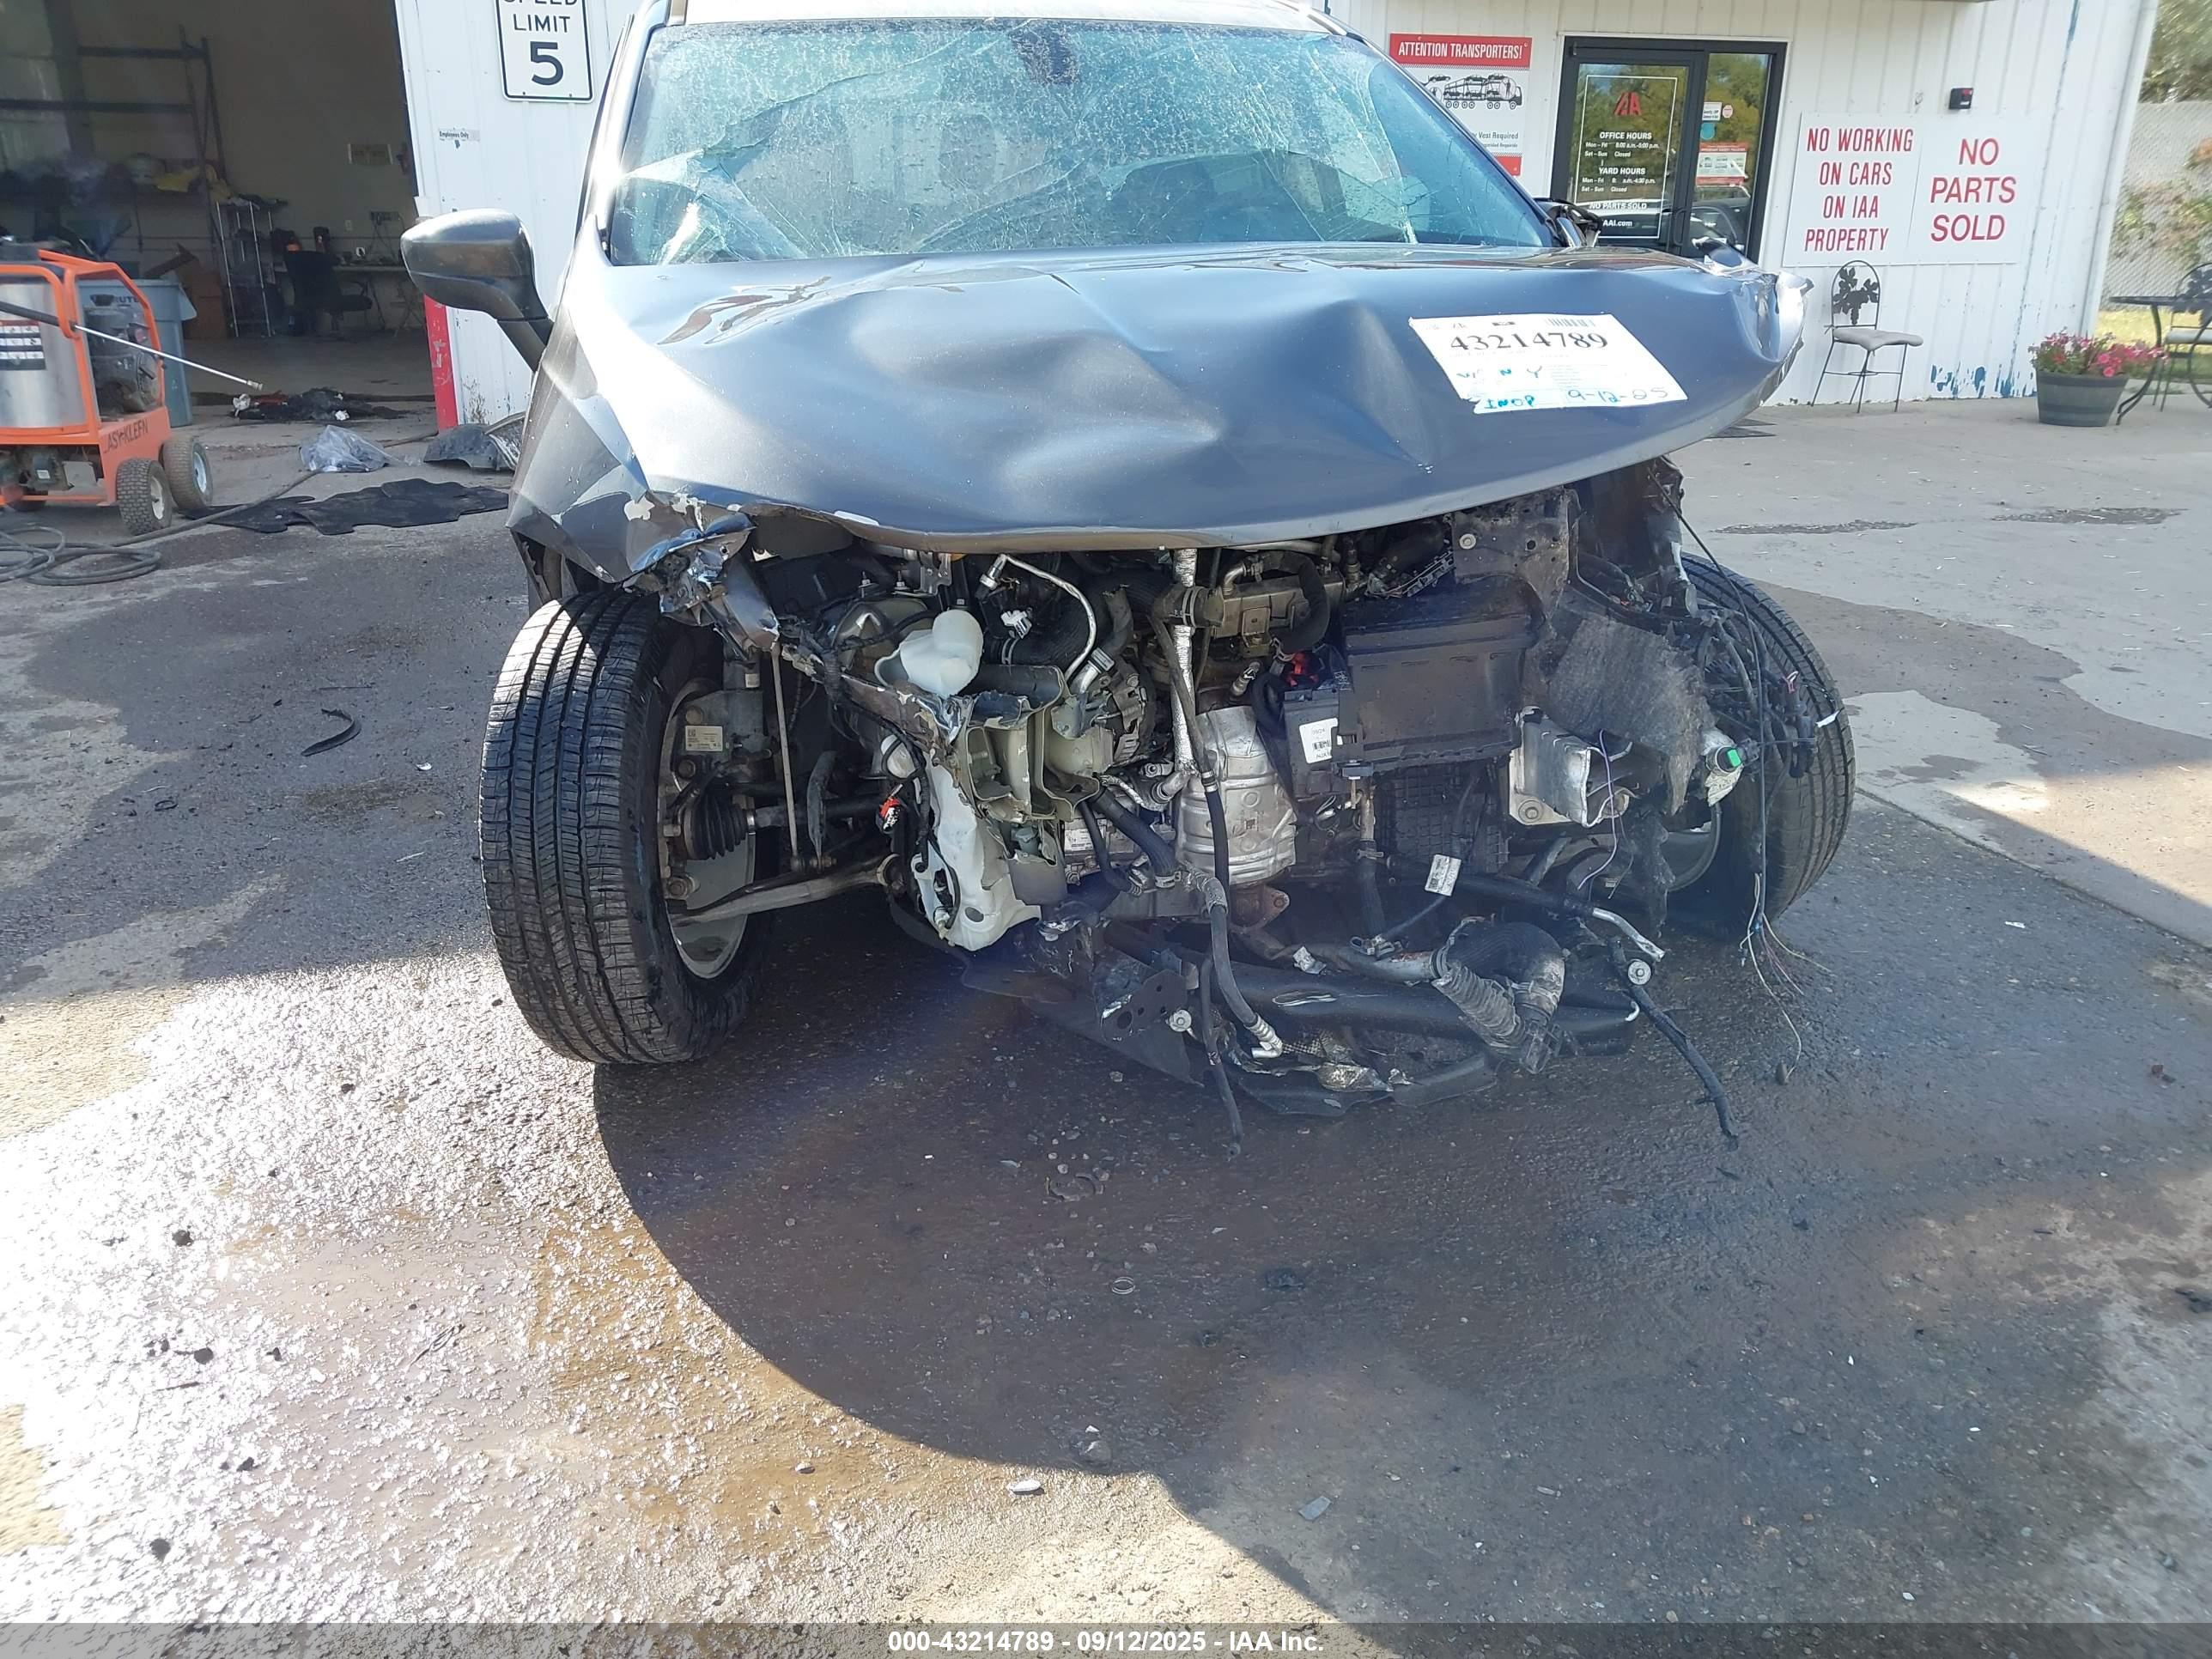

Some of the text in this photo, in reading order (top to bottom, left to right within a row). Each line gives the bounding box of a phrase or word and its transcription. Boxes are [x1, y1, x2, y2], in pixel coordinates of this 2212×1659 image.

[514, 14, 570, 33] LIMIT
[1398, 41, 1522, 59] ATTENTION TRANSPORTERS!
[530, 40, 564, 86] 5
[1492, 131, 1519, 141] Required
[1807, 128, 1914, 152] NO WORKING
[1959, 137, 1999, 166] NO
[1820, 161, 1893, 185] ON CARS
[1930, 176, 2016, 204] PARTS
[1823, 195, 1879, 219] ON IAA
[1930, 214, 2005, 241] SOLD
[1804, 228, 1889, 252] PROPERTY
[1449, 332, 1608, 351] 43214789
